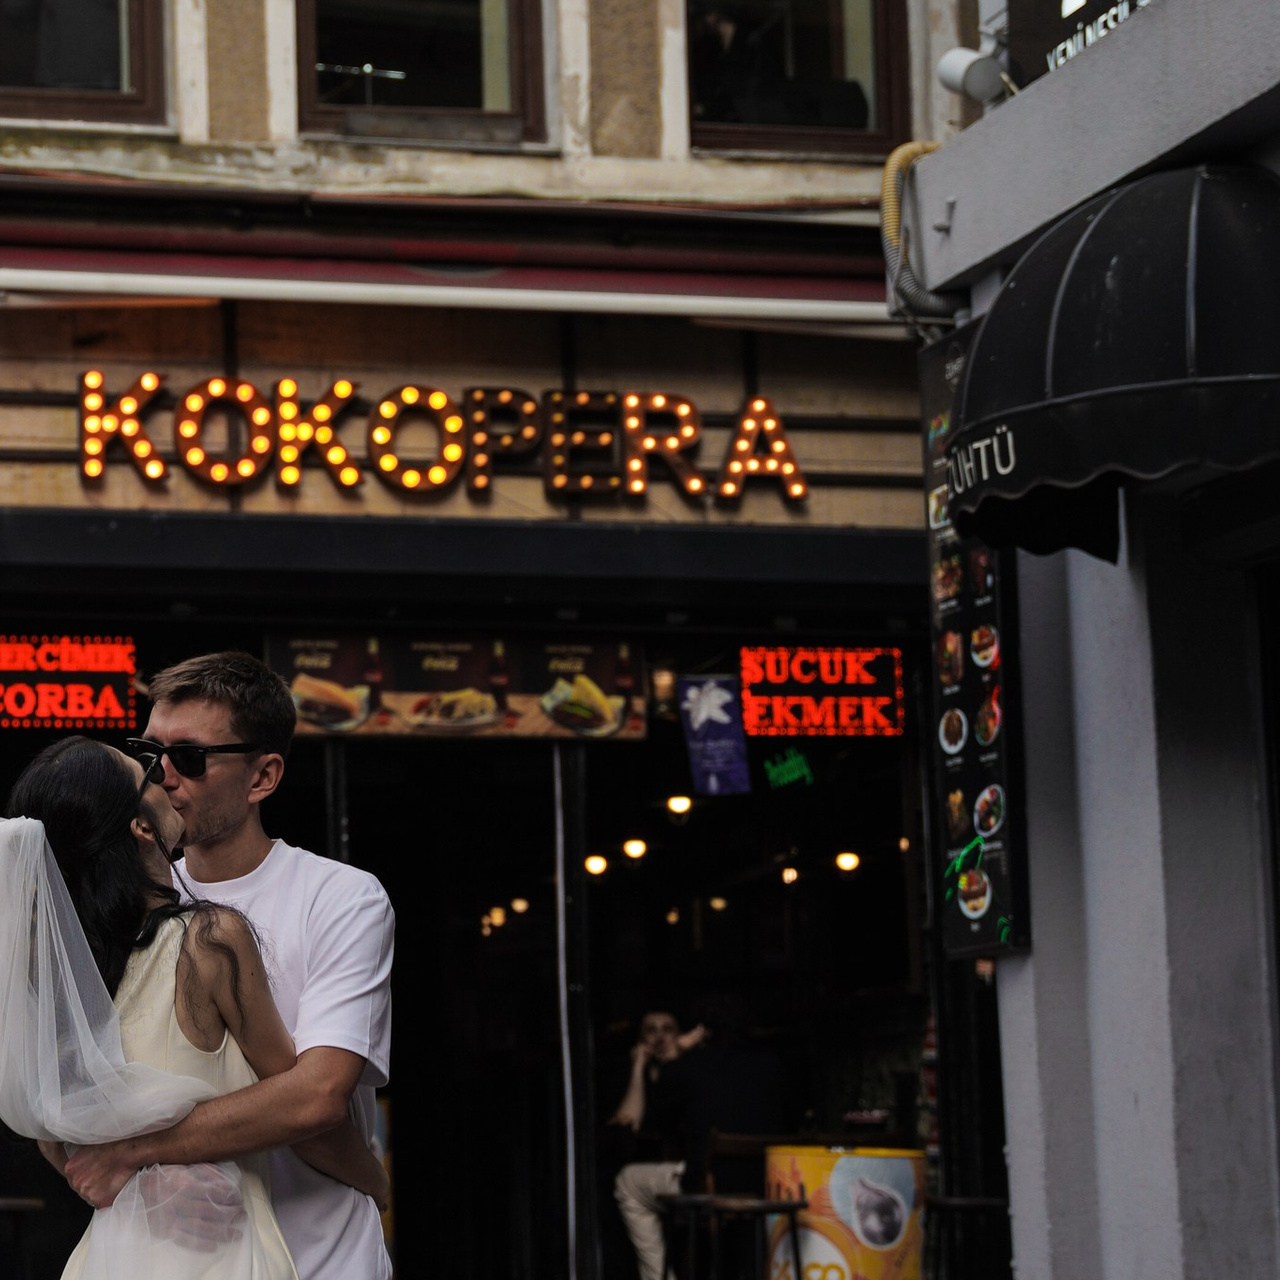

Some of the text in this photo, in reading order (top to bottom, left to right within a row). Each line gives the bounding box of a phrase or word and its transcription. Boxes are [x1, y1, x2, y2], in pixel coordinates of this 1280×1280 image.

[80, 369, 807, 502] KOKOPERA
[741, 649, 877, 684] SUCUK
[743, 695, 893, 728] EKMEK
